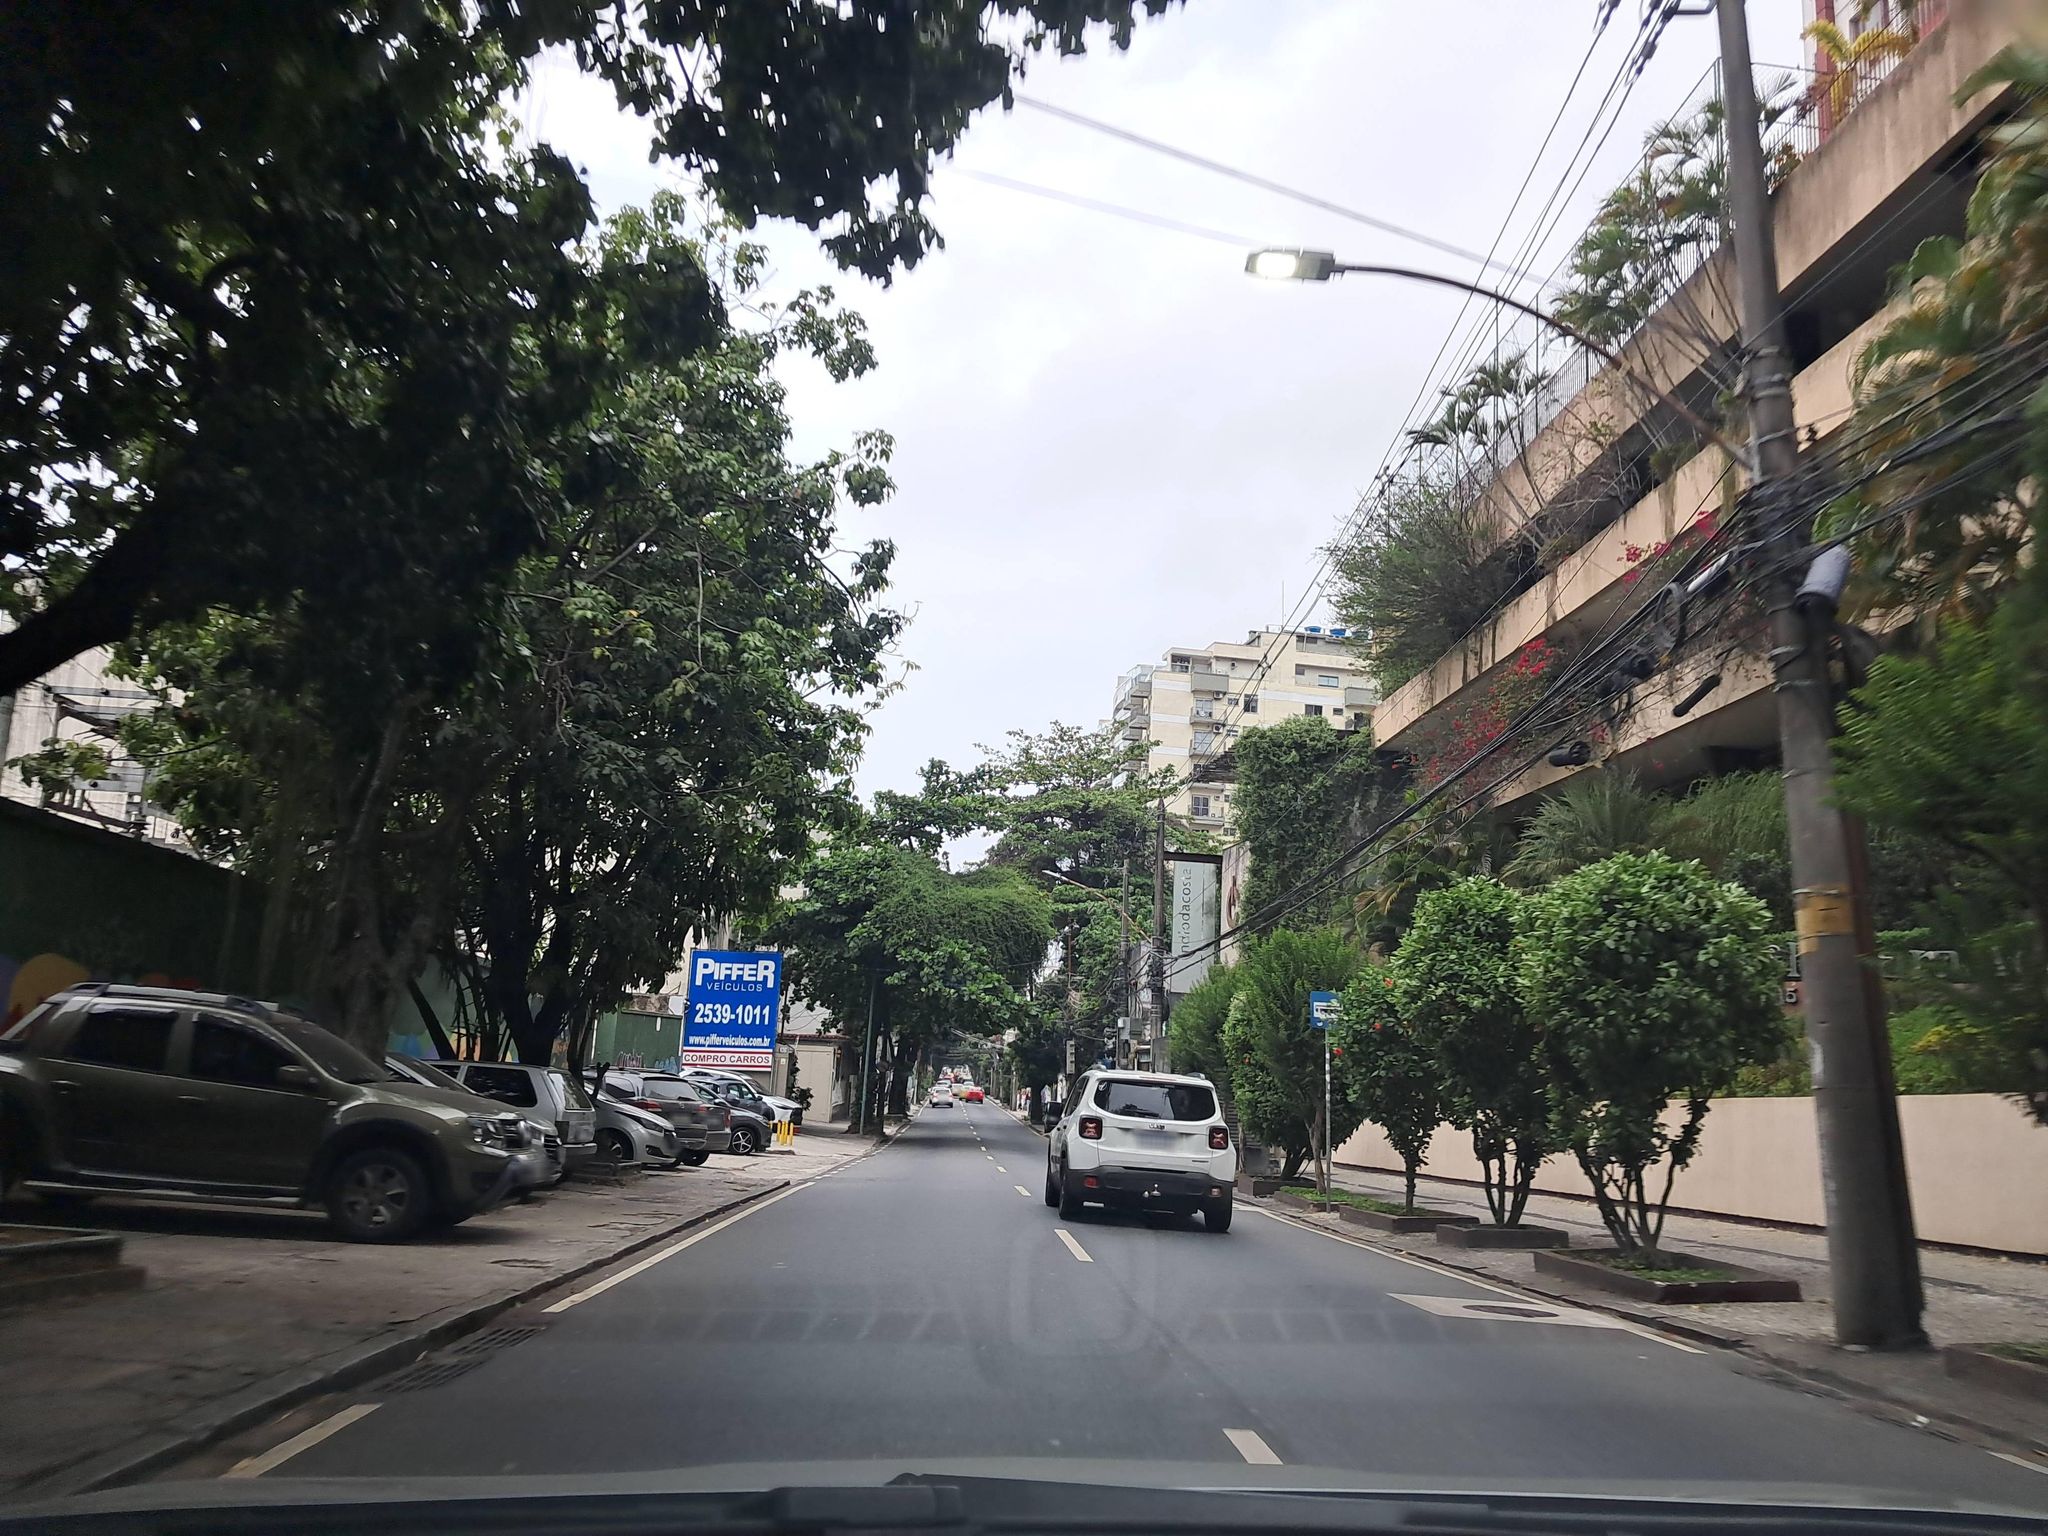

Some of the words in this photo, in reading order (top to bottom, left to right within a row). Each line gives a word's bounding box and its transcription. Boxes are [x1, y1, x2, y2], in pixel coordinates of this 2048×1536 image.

[695, 958, 776, 988] PIFFER
[706, 982, 763, 992] VEÍCULOS
[694, 1003, 770, 1025] 2539-1011
[688, 1033, 771, 1047] www.pifferveiculos.com.br
[684, 1054, 727, 1063] COMPRO
[729, 1055, 770, 1064] CARROS
